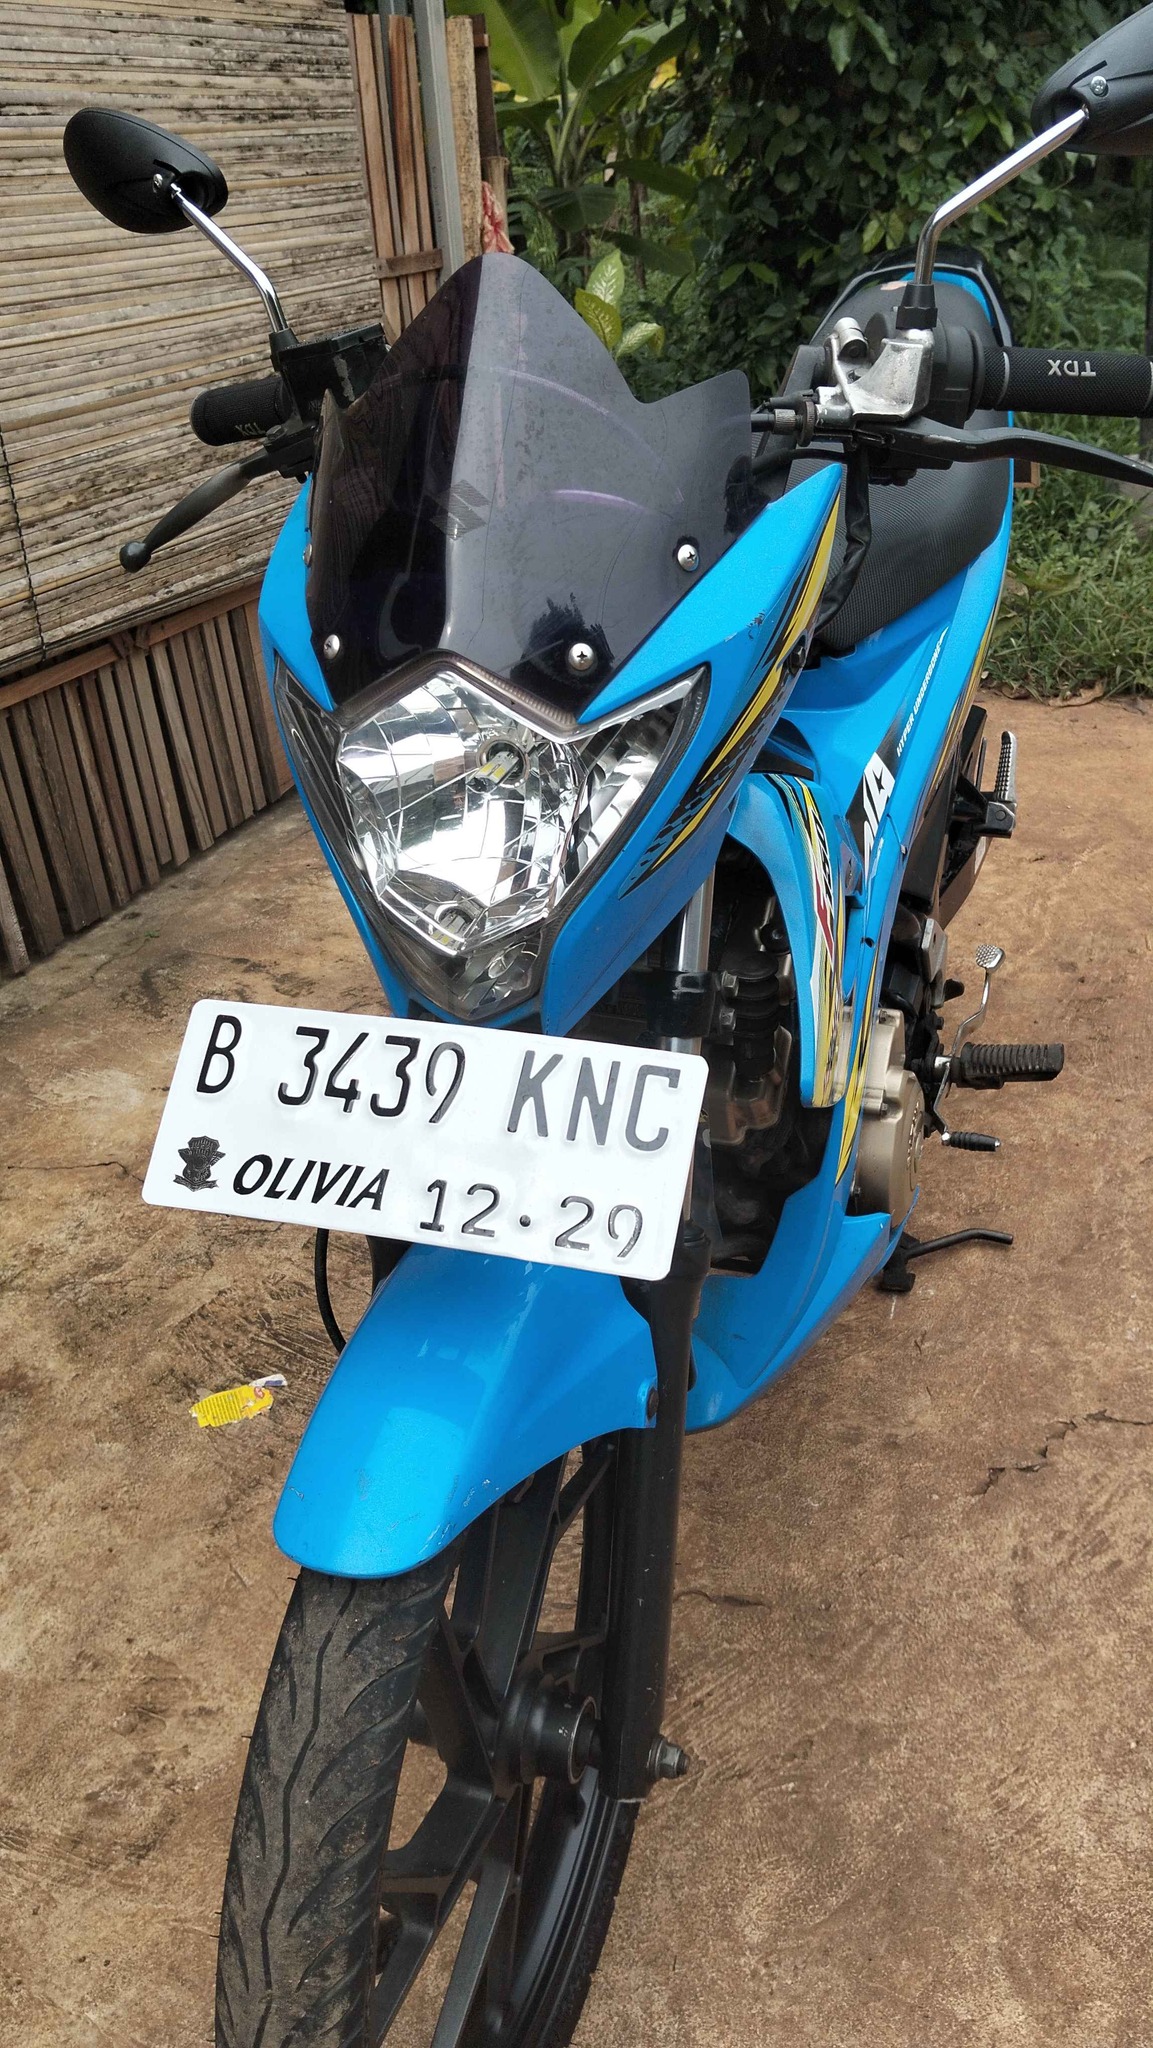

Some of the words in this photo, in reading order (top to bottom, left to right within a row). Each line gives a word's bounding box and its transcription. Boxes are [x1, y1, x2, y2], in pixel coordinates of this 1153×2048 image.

[1047, 359, 1097, 377] TDX
[896, 712, 915, 758] HYPER
[913, 640, 942, 715] UNDERBONE
[195, 1014, 243, 1094] B
[278, 1025, 466, 1124] 3439
[506, 1050, 681, 1152] KNC
[233, 1153, 390, 1211] OLIVIA
